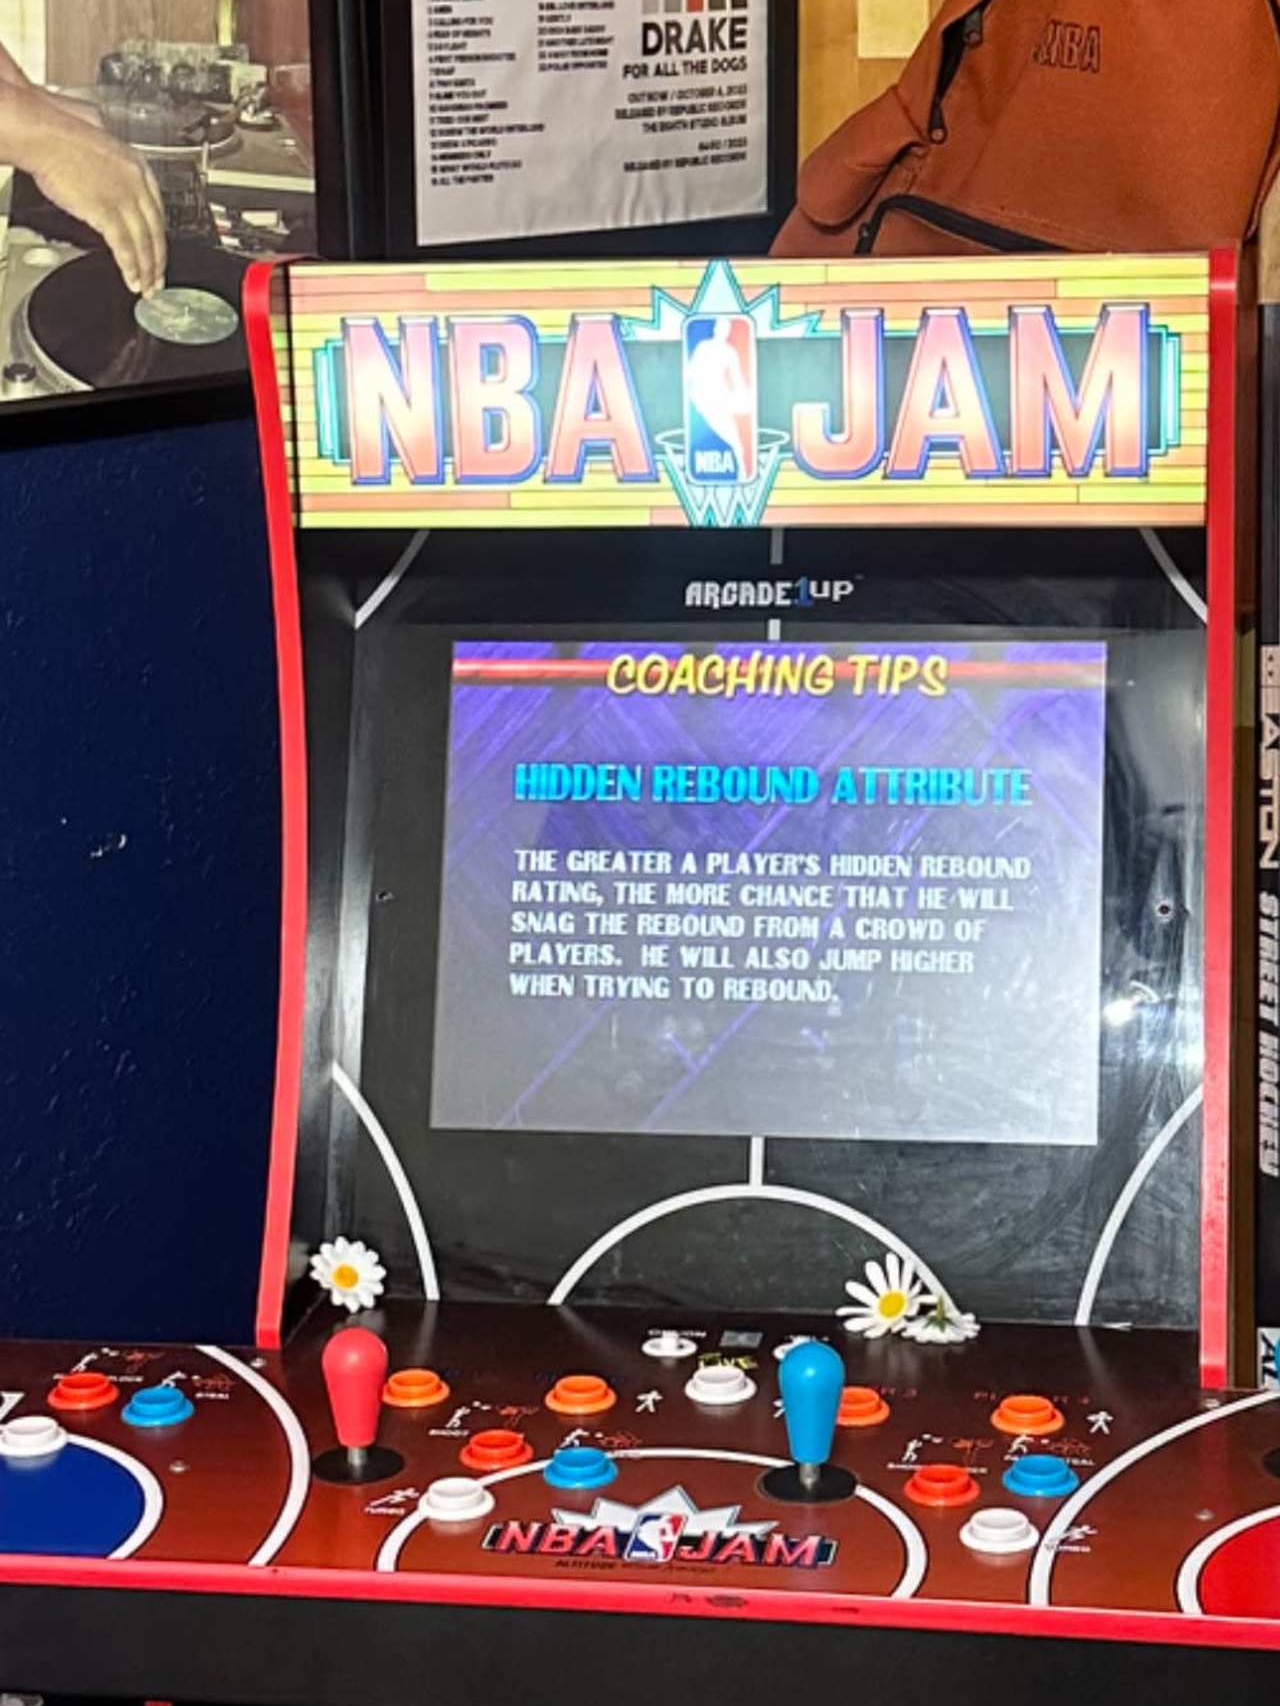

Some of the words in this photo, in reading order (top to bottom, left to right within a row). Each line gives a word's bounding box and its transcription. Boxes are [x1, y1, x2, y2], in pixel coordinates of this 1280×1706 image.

[642, 17, 747, 56] DRAKE
[623, 64, 648, 78] FOR
[654, 63, 678, 76] ALL
[682, 60, 707, 74] THE
[711, 56, 747, 73] DOGS
[344, 311, 661, 485] NBA
[792, 303, 1150, 480] JAM
[696, 450, 736, 475] NBA
[685, 575, 854, 609] ARCADE1UP
[607, 651, 835, 698] COACHING
[849, 654, 949, 696] TIPS
[514, 763, 639, 803] HIDDEN
[652, 766, 818, 804] REBOUND
[832, 768, 1032, 806] ATTRIBUTE
[516, 850, 557, 872] THE
[566, 850, 671, 873] GREATER
[682, 853, 697, 873] A
[708, 853, 820, 876] PLAYER'S
[829, 855, 911, 877] HIDDEN
[922, 856, 1031, 880] REBOUND
[512, 882, 604, 907] RATING,
[615, 883, 657, 904] THE
[667, 883, 730, 907] MORE
[741, 885, 832, 908] CHANCE
[845, 886, 905, 908] THAT
[918, 887, 946, 909] HE
[957, 887, 1014, 911] WILL
[511, 912, 575, 935] SNAG
[585, 913, 628, 936] THE
[638, 914, 745, 938] REBOUND
[754, 916, 819, 939] FROM
[829, 918, 845, 939] A
[856, 918, 945, 941] CROWD
[954, 919, 985, 941] OF
[510, 944, 622, 967] PLAYERS.
[642, 945, 671, 967] HE
[680, 946, 736, 968] WILL
[746, 947, 809, 971] ALSO
[819, 948, 881, 972] JUMP
[891, 949, 975, 973] HIGHER
[1257, 889, 1280, 1026] STREET
[510, 974, 574, 997] WHEN
[584, 976, 670, 999] TRYING
[680, 977, 714, 999] TO
[724, 979, 839, 1002] REBOUND.
[1257, 1031, 1280, 1179] HOCKEY
[495, 1521, 617, 1557] NBA
[678, 1533, 822, 1567] JAM
